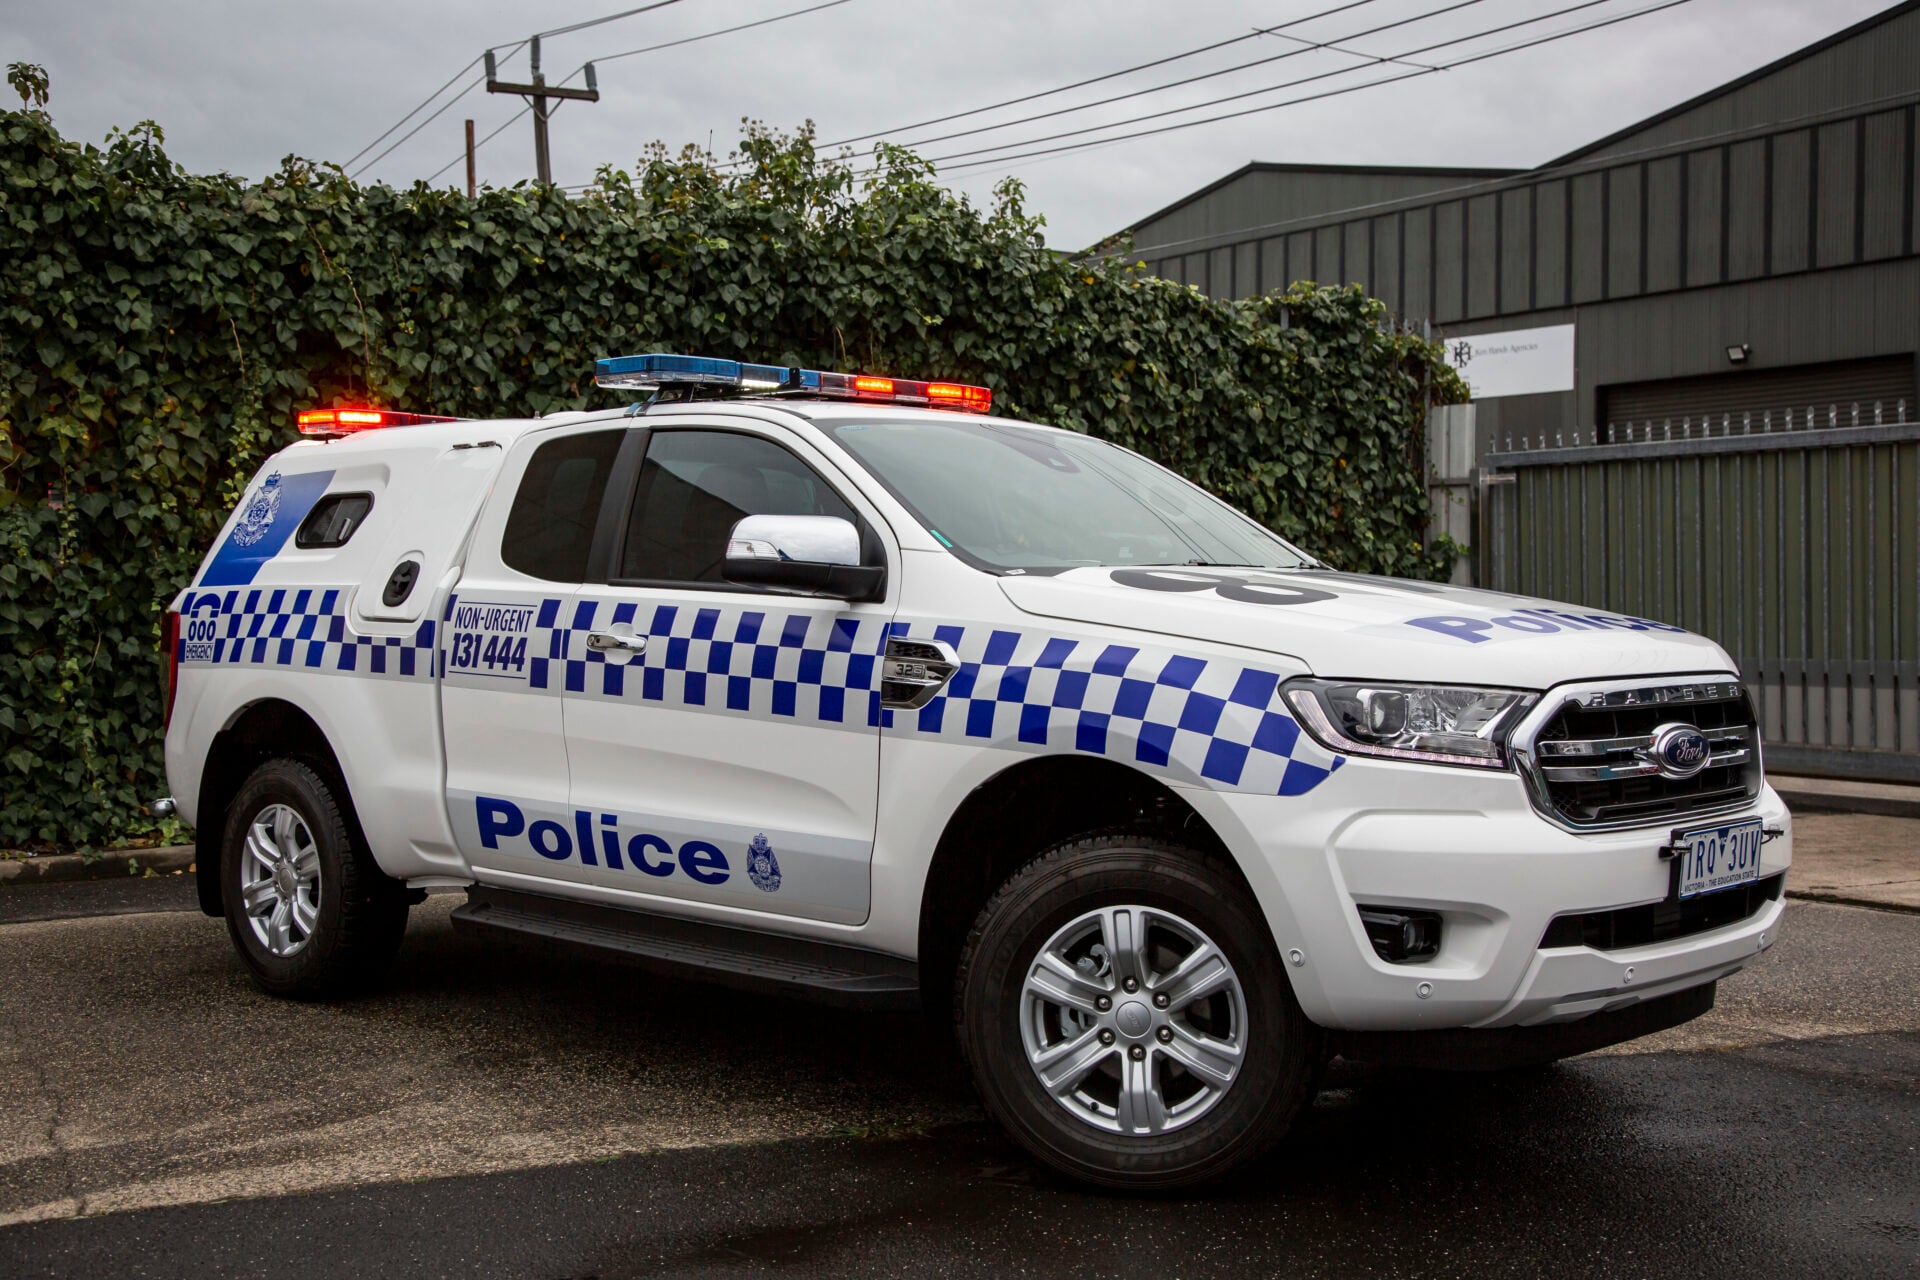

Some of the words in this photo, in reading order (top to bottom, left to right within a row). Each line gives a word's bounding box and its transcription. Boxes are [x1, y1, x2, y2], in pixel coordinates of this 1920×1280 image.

[188, 620, 216, 642] 000
[454, 606, 534, 633] NON-URGENT
[1403, 608, 1687, 644] Police
[450, 632, 483, 668] 131
[482, 635, 528, 672] 444
[1676, 737, 1704, 763] Ford
[476, 796, 730, 885] Police
[1687, 838, 1715, 880] 1RQ
[1728, 829, 1760, 871] 3UV
[1684, 881, 1705, 892] VICTORIA
[1709, 877, 1717, 887] THE
[1717, 873, 1741, 885] EDUCATION
[1742, 870, 1754, 880] STATE
